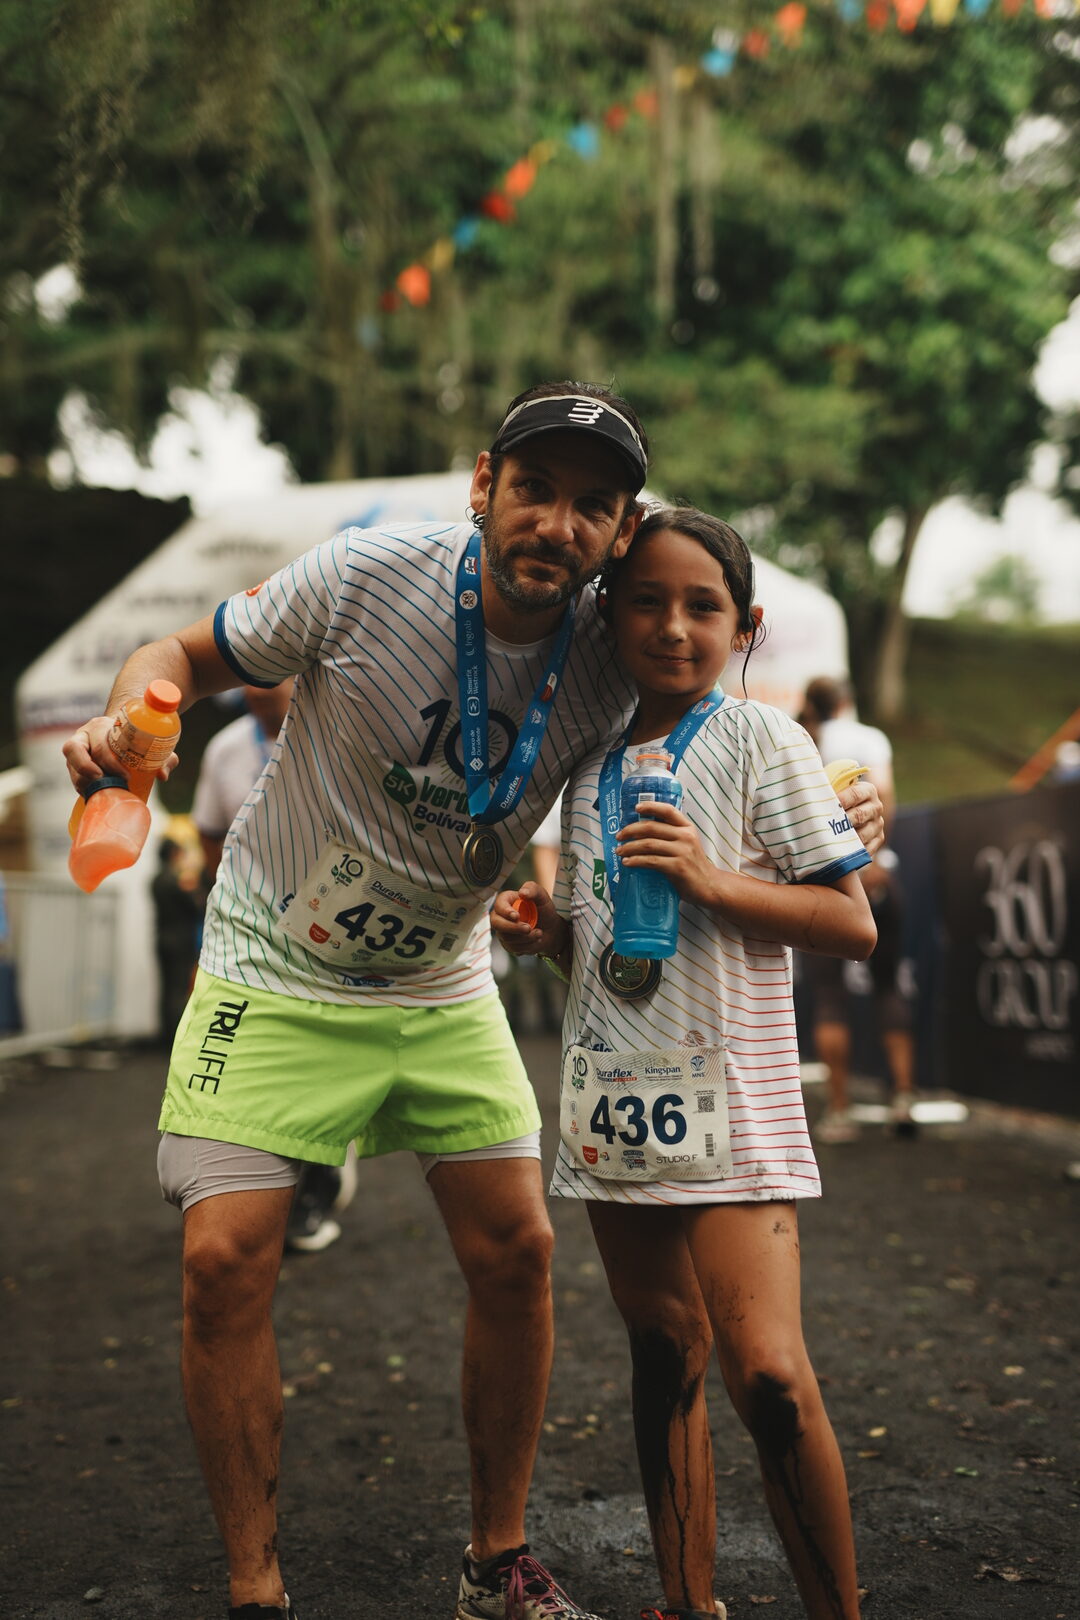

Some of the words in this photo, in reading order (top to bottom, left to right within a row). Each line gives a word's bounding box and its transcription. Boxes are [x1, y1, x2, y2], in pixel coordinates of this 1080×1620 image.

[420, 775, 470, 815] Verd
[500, 775, 520, 809] Duraflex
[341, 853, 363, 876] 10
[372, 880, 411, 905] Duraflex
[334, 902, 437, 959] 435
[188, 1000, 249, 1094] TRILIFE
[572, 1056, 587, 1076] 10
[596, 1067, 633, 1078] Duraflex
[645, 1066, 681, 1075] Kingspan
[590, 1093, 687, 1147] 436
[656, 1155, 690, 1164] STUDIO
